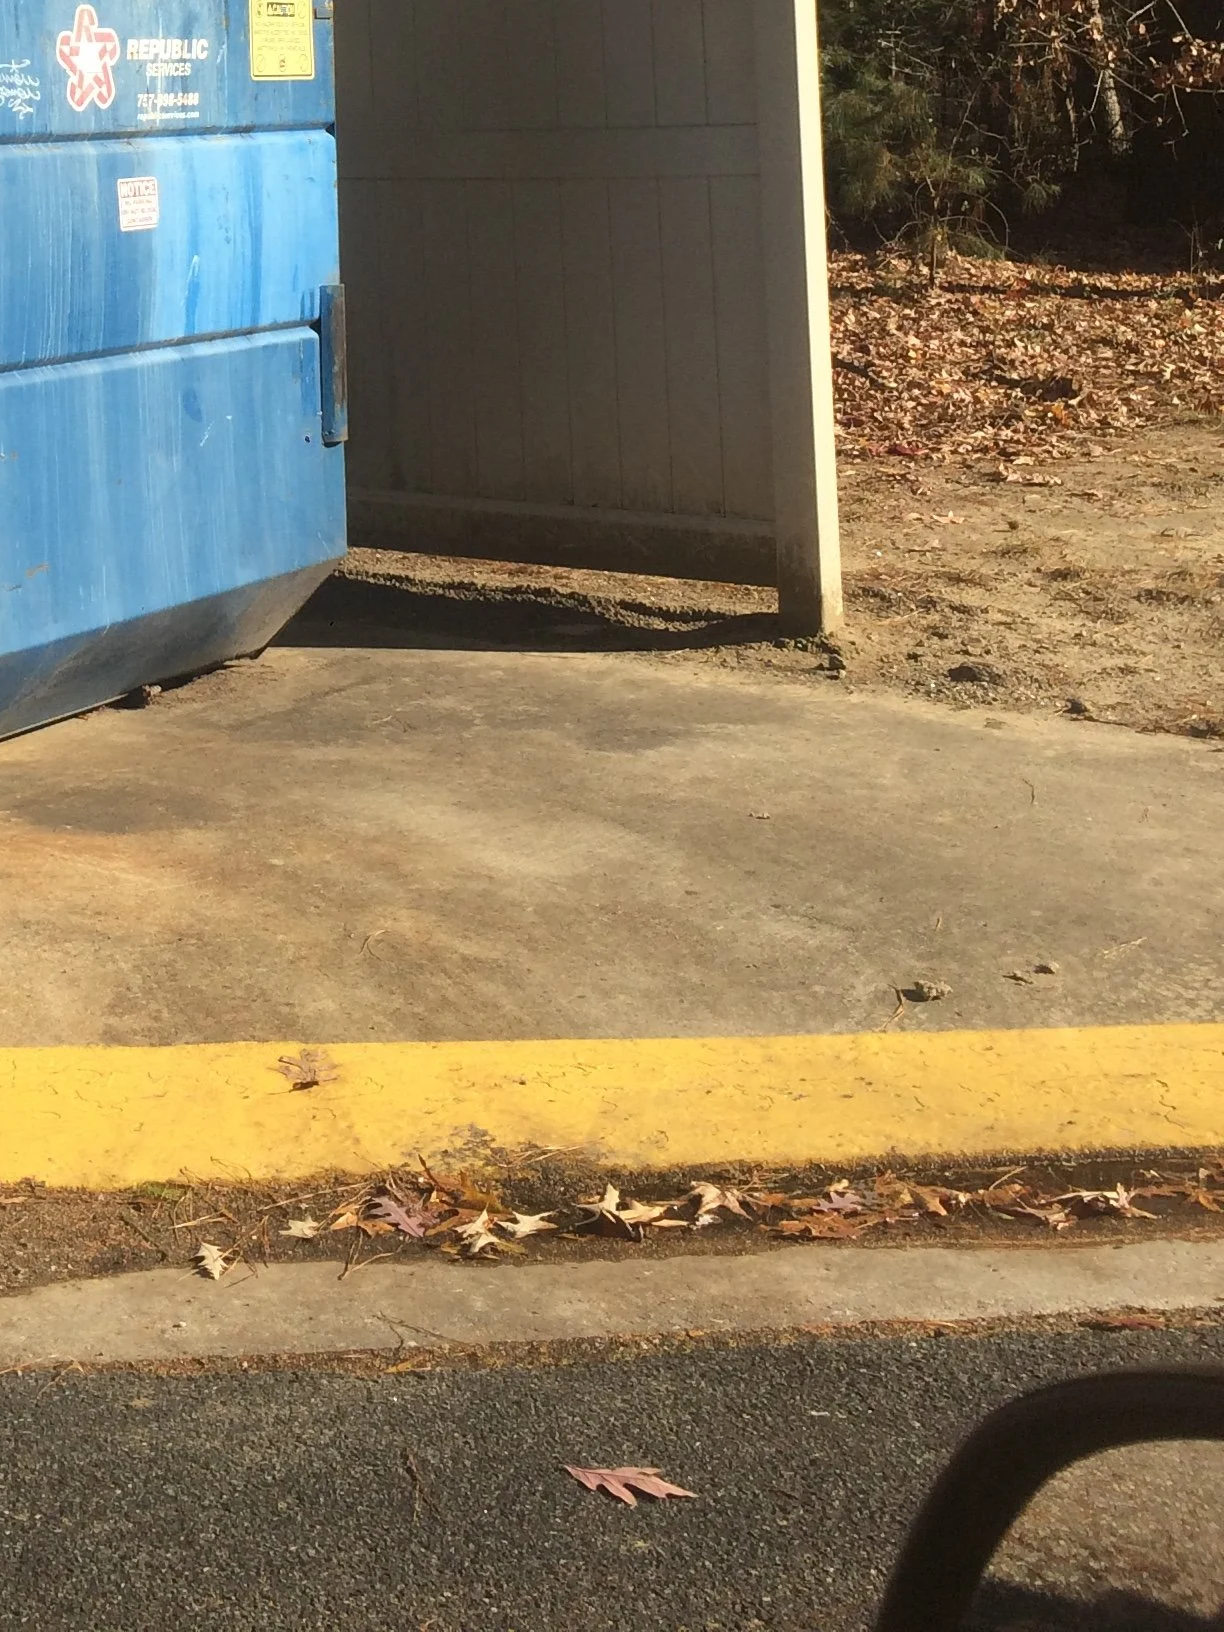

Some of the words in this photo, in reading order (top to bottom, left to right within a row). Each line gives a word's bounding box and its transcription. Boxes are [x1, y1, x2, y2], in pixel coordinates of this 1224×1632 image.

[126, 38, 209, 60] REPUBLIC
[146, 62, 192, 77] SERVICES
[120, 181, 156, 198] NOTICE
